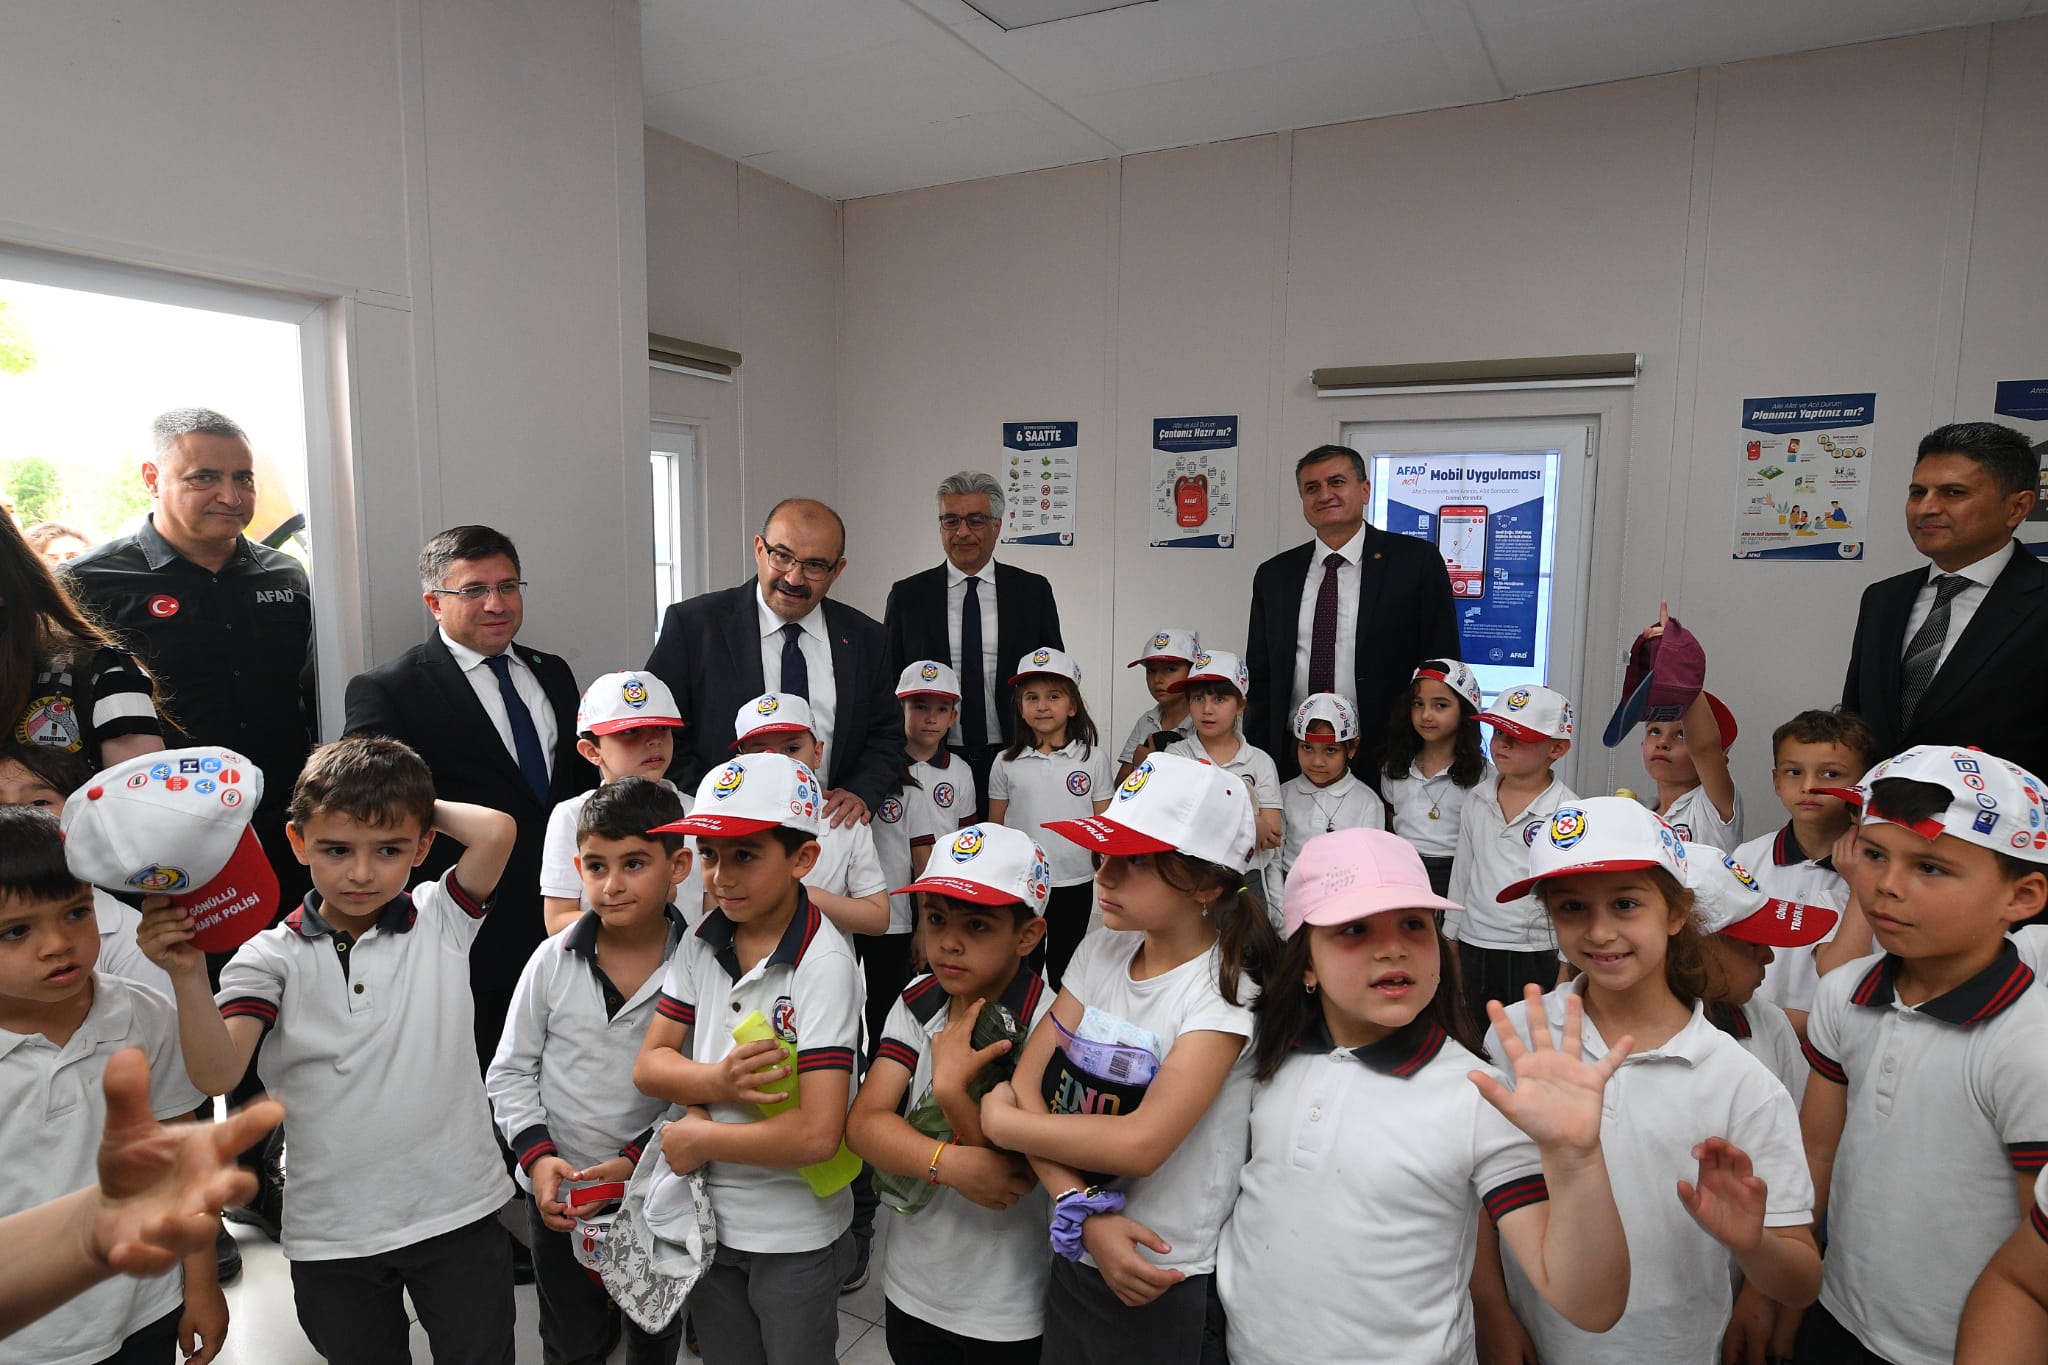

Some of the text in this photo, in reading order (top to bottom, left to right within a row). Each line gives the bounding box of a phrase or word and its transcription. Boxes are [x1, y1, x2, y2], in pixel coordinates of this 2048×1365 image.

[1752, 407, 1864, 420] Planınızı Yaptınız mı?
[1016, 430, 1061, 442] 6 SAATTE
[1160, 427, 1232, 440] Çantanız Hazır mı?
[1396, 466, 1540, 483] AFAD Mobil Uygulaması
[256, 590, 294, 603] AFAD
[1962, 762, 1975, 770] D
[189, 887, 238, 917] GÖNÜLLÜ
[193, 892, 260, 932] RAFİK POLİSİ
